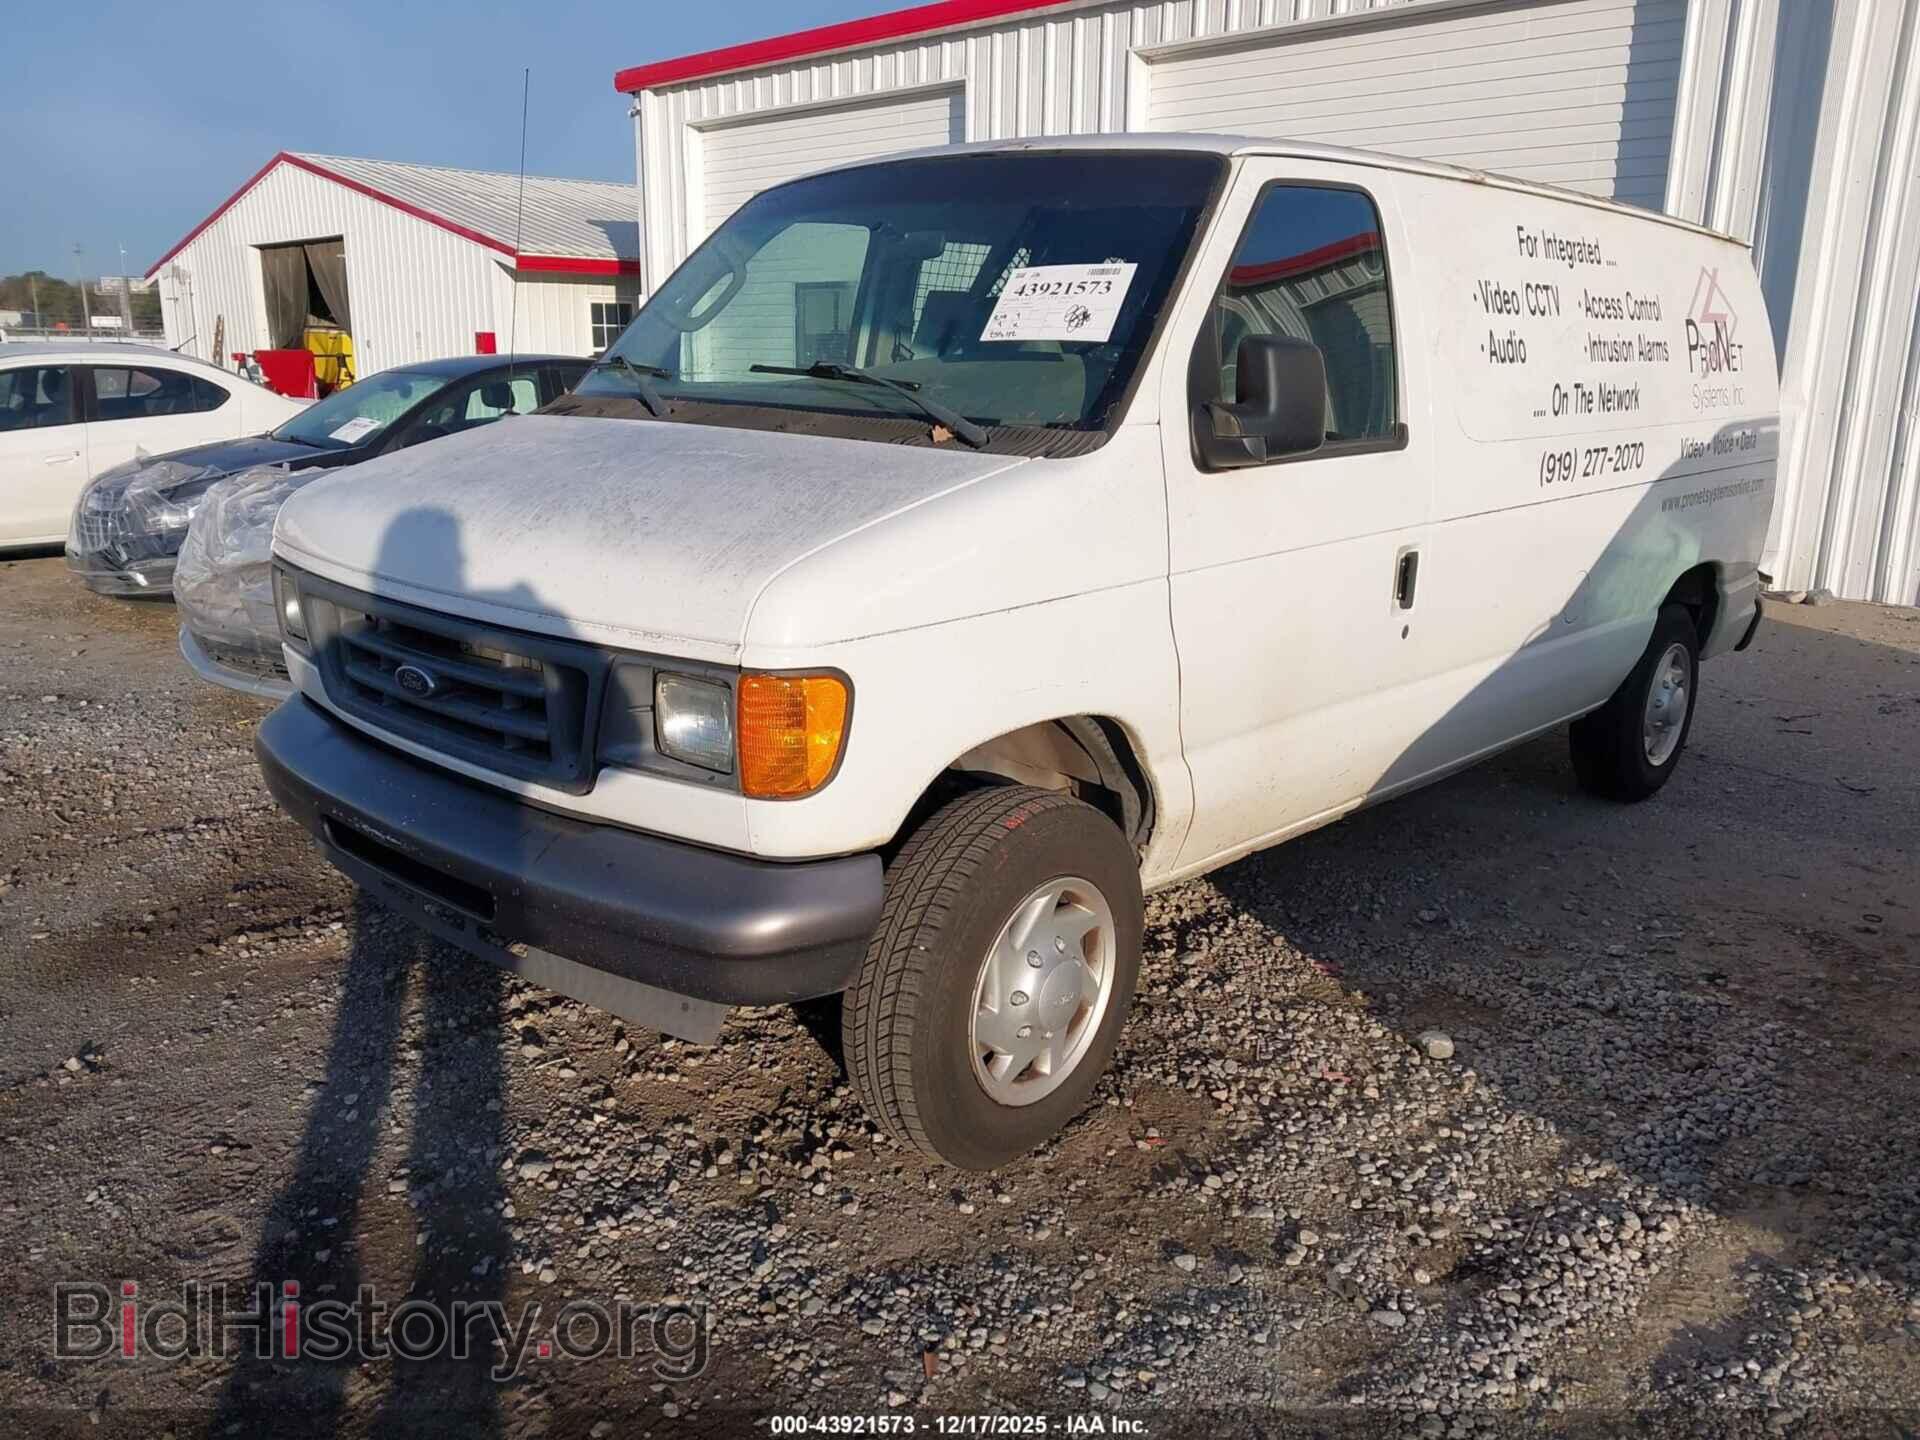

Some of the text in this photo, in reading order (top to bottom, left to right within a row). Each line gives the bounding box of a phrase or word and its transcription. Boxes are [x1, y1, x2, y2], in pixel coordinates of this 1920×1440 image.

[1516, 225, 1538, 258] For
[1542, 228, 1601, 269] Integrated
[1013, 280, 1112, 297] 43921573
[1583, 288, 1663, 322] Access Control
[1489, 329, 1527, 364] Audio
[1587, 331, 1669, 363] Intrusion Alarms
[1552, 382, 1569, 417] On
[1574, 382, 1594, 414] The
[1598, 381, 1640, 413] Network
[1692, 382, 1729, 414] Systems
[1680, 430, 1758, 460] Video Voice Data
[1539, 441, 1645, 488] (919) 277-2070
